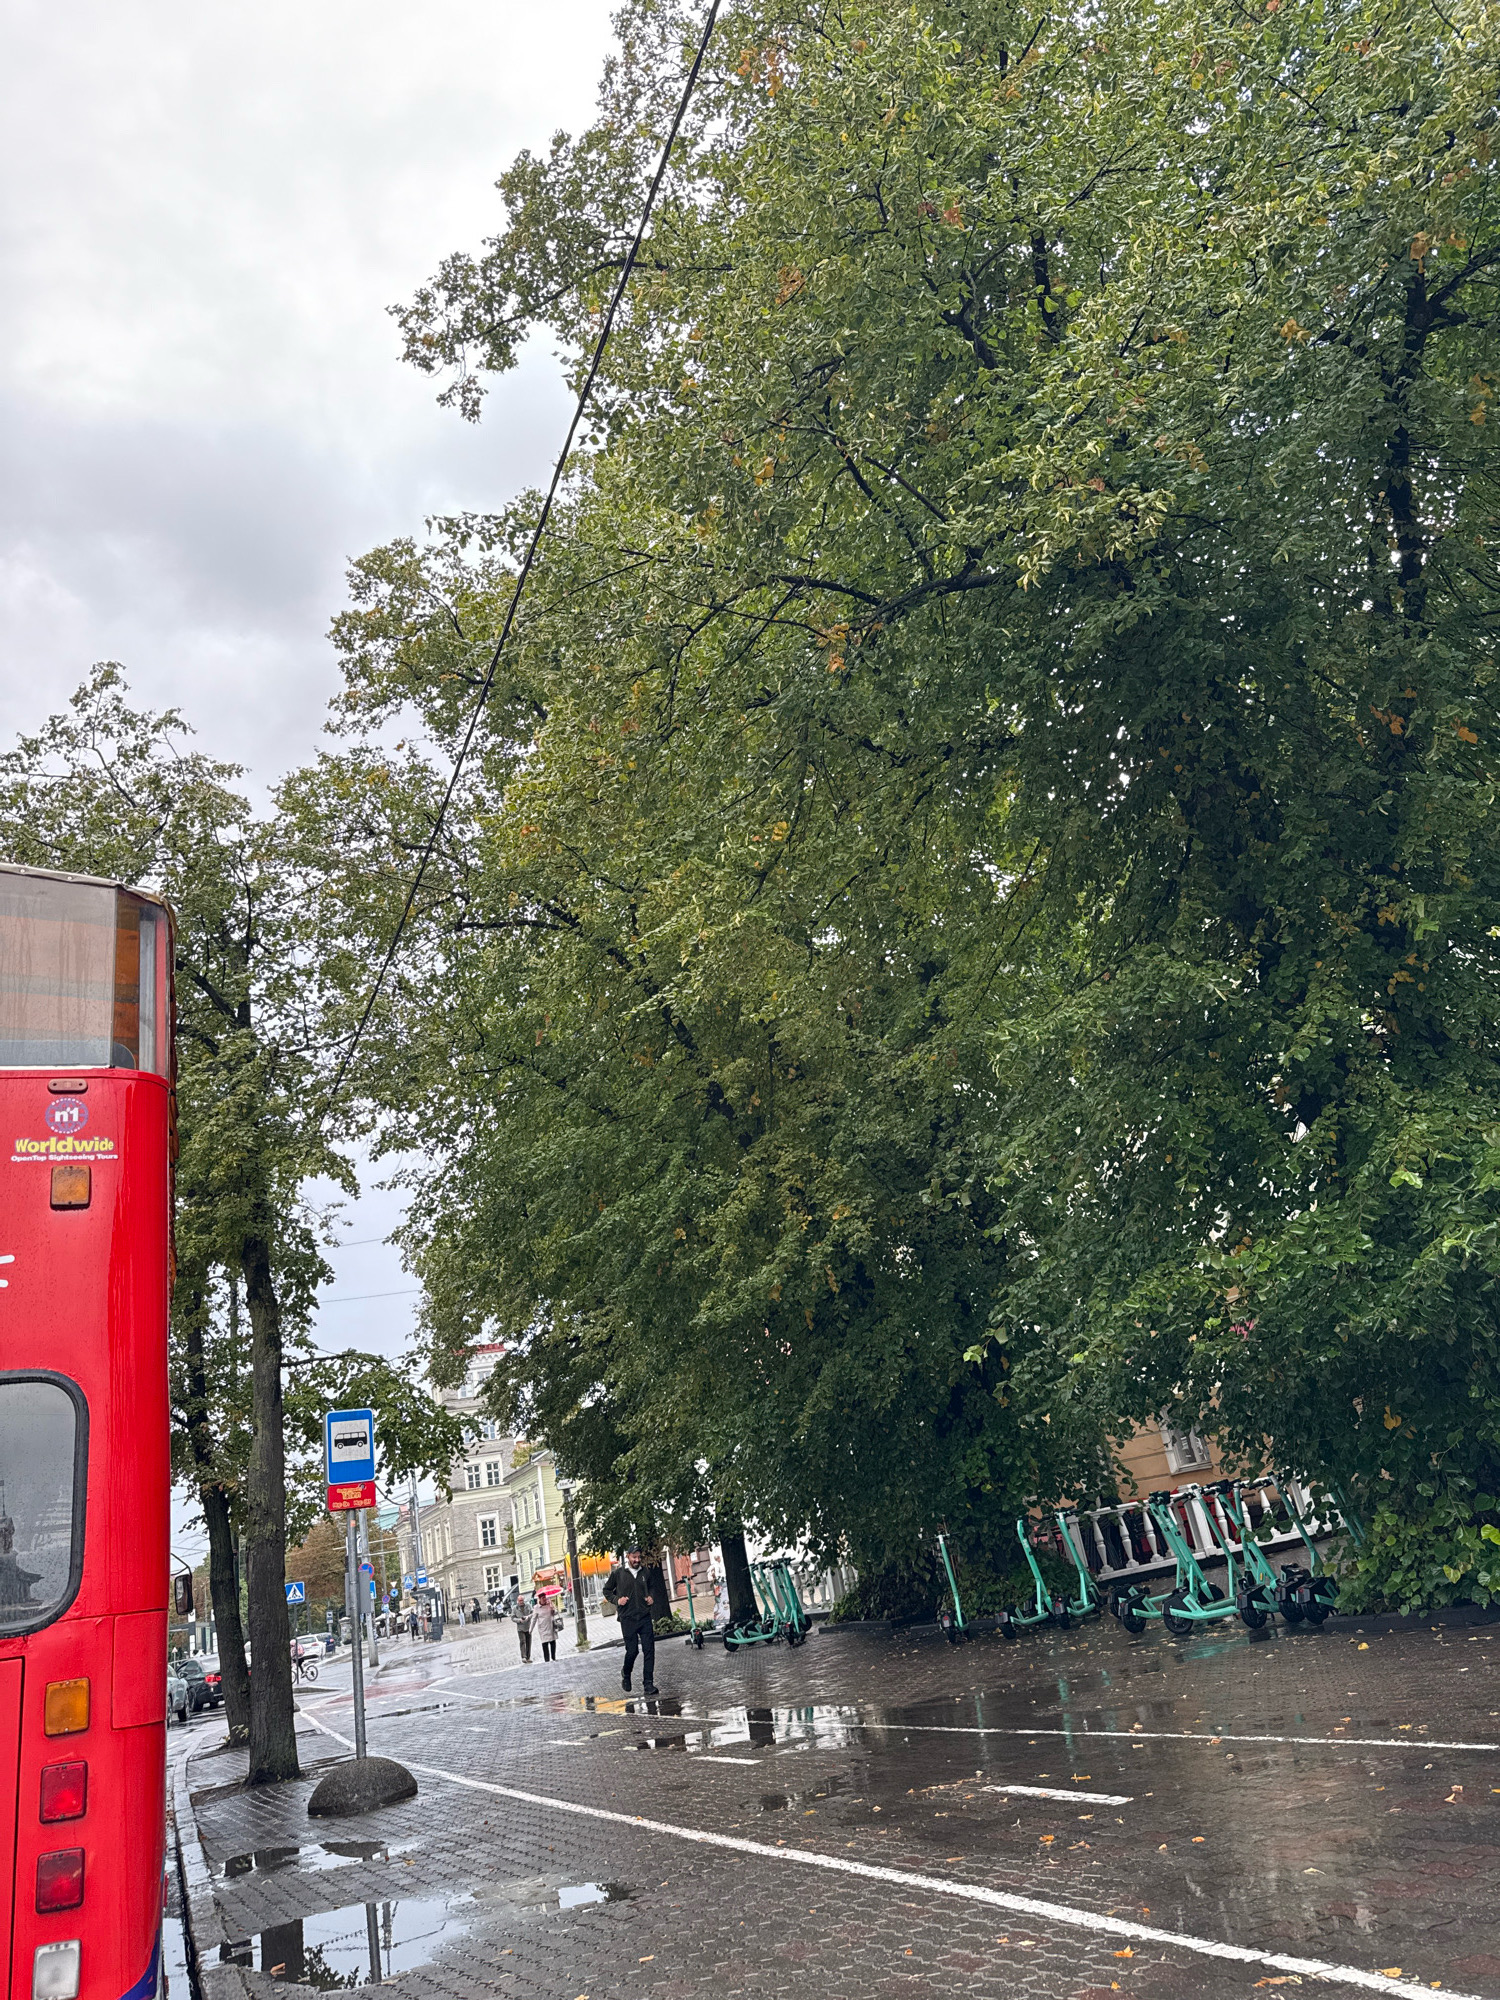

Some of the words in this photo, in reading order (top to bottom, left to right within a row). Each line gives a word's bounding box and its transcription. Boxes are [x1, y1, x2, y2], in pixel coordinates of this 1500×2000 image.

[15, 1137, 115, 1153] Worldwide
[11, 1154, 47, 1162] OpenTop
[48, 1154, 95, 1162] Sightseeing
